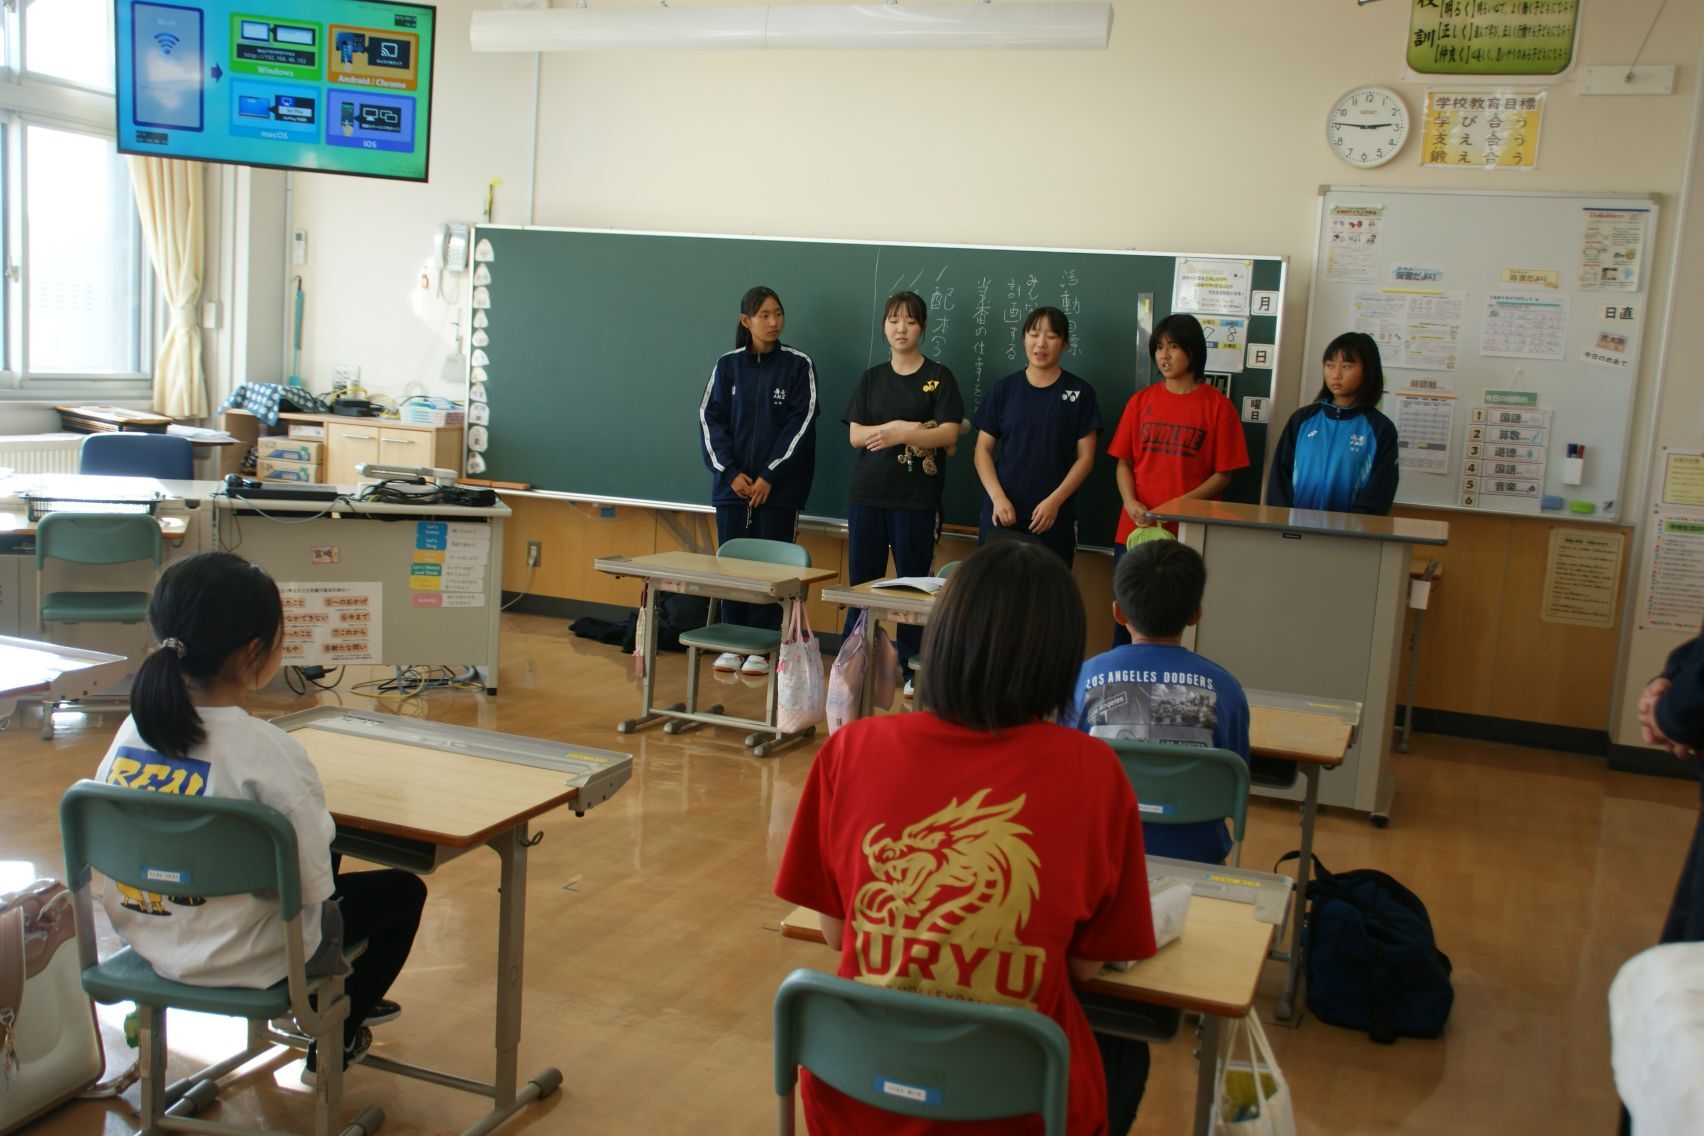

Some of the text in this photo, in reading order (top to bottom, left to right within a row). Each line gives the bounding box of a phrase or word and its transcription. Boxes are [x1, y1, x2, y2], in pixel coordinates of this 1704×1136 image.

[256, 65, 295, 77] Windows
[338, 74, 370, 85] Android
[376, 77, 407, 89] Chrome
[1435, 97, 1536, 110] 学校教育目標
[1433, 114, 1526, 129] 学び合う
[261, 130, 288, 139] macOS
[1432, 132, 1525, 147] 支え合う
[363, 140, 377, 148] iOS
[1430, 149, 1523, 165] 鍛え合う
[1259, 297, 1270, 311] 月
[1605, 306, 1634, 320] 日直
[1226, 326, 1238, 342] 8
[1256, 350, 1267, 363] 日
[1585, 351, 1628, 367] 今日のめあて
[1250, 399, 1262, 420] 曜日
[1476, 411, 1482, 420] 1
[1500, 412, 1522, 423] 国語
[1473, 430, 1481, 439] 2
[1498, 430, 1521, 440] 算数
[1470, 447, 1479, 455] 3
[1467, 464, 1477, 472] 4
[1495, 463, 1517, 474] 国語
[1468, 480, 1475, 489] 5
[1464, 496, 1473, 504] 6
[1086, 670, 1214, 690] LOS ANGELES DODGERS
[864, 931, 1038, 1000] URYU
